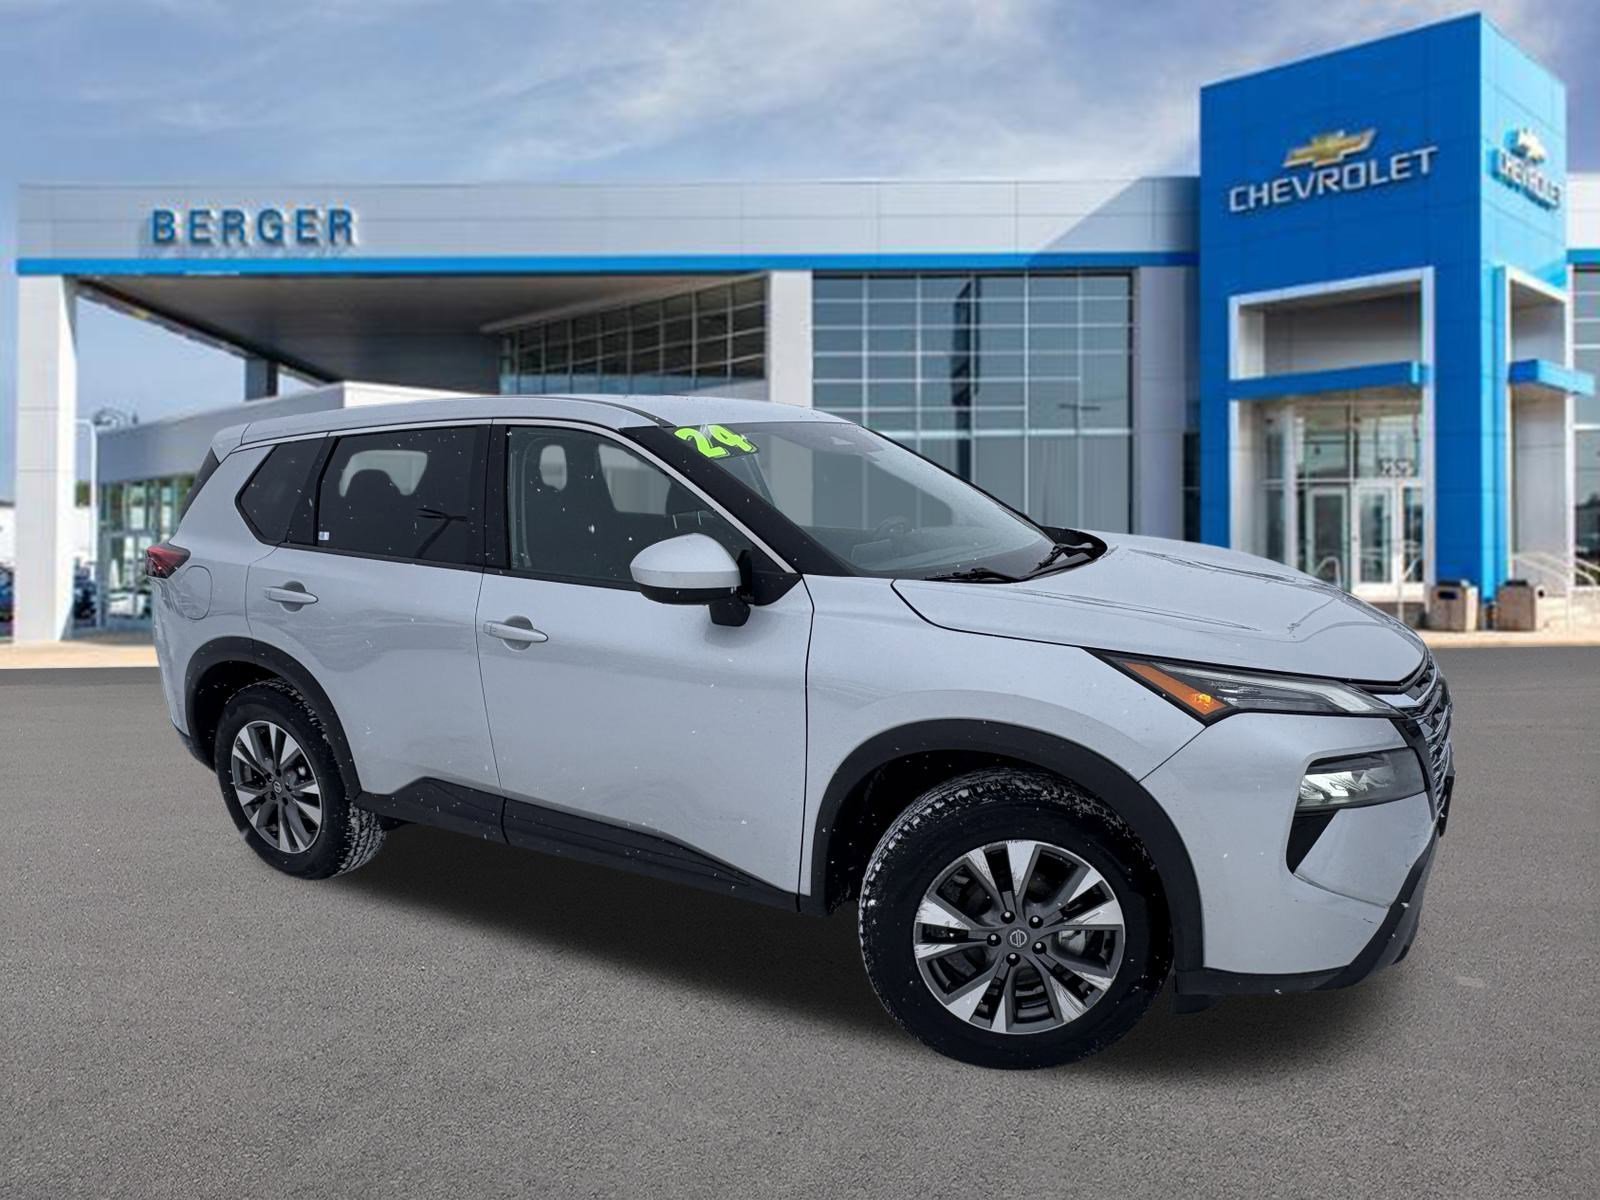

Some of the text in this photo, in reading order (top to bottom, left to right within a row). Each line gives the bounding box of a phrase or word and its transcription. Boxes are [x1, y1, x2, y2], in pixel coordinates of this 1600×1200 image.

[1229, 146, 1438, 213] CHEVROLET
[152, 208, 354, 246] BERGER
[673, 424, 757, 458] 24
